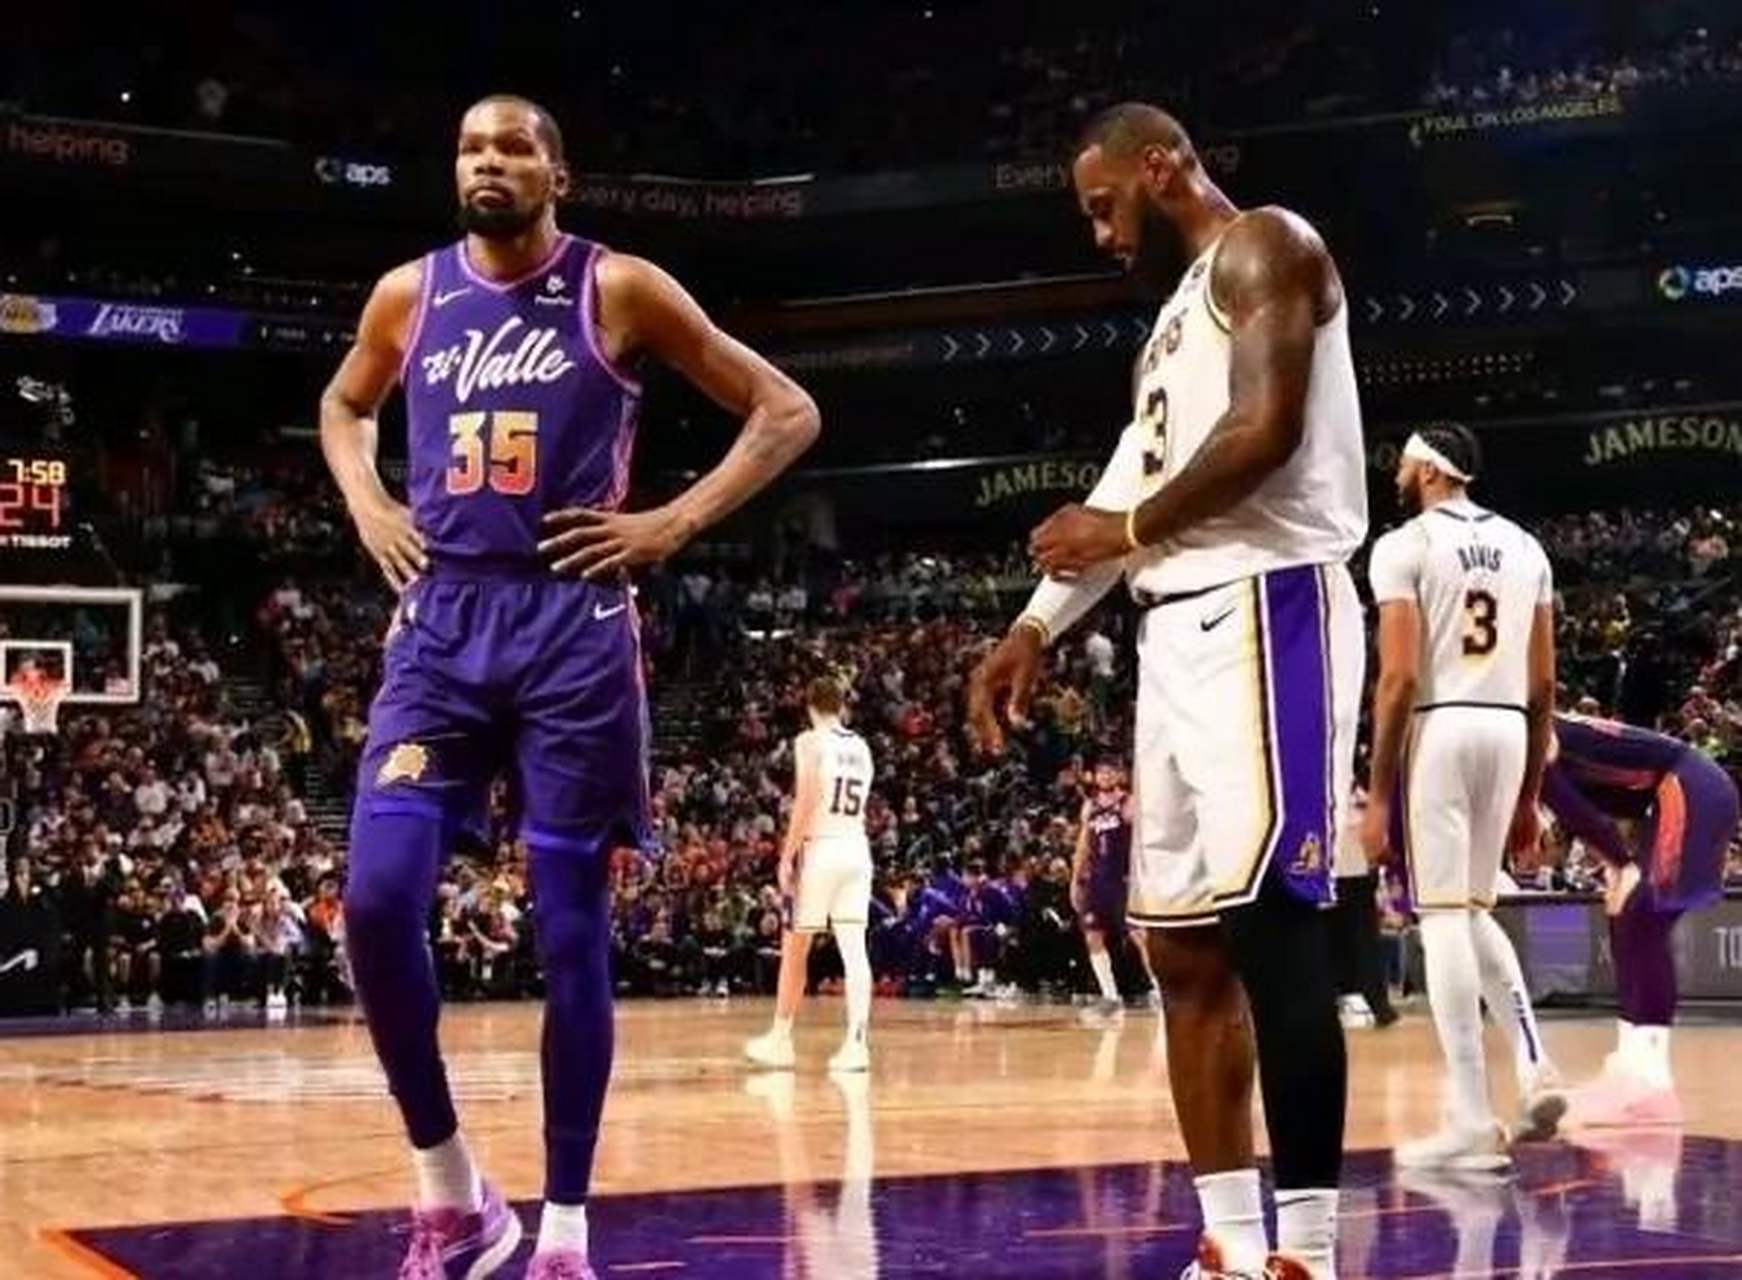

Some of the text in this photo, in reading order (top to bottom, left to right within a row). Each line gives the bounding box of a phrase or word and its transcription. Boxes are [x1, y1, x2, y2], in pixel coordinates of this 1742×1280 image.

[345, 162, 390, 188] aps
[573, 184, 637, 215] very
[456, 316, 576, 403] Valle
[8, 459, 66, 485] 7:58
[446, 410, 539, 495] 35
[0, 483, 60, 527] 24
[975, 462, 1100, 506] JAMESO
[1462, 589, 1498, 656] 3
[830, 776, 863, 817] 15
